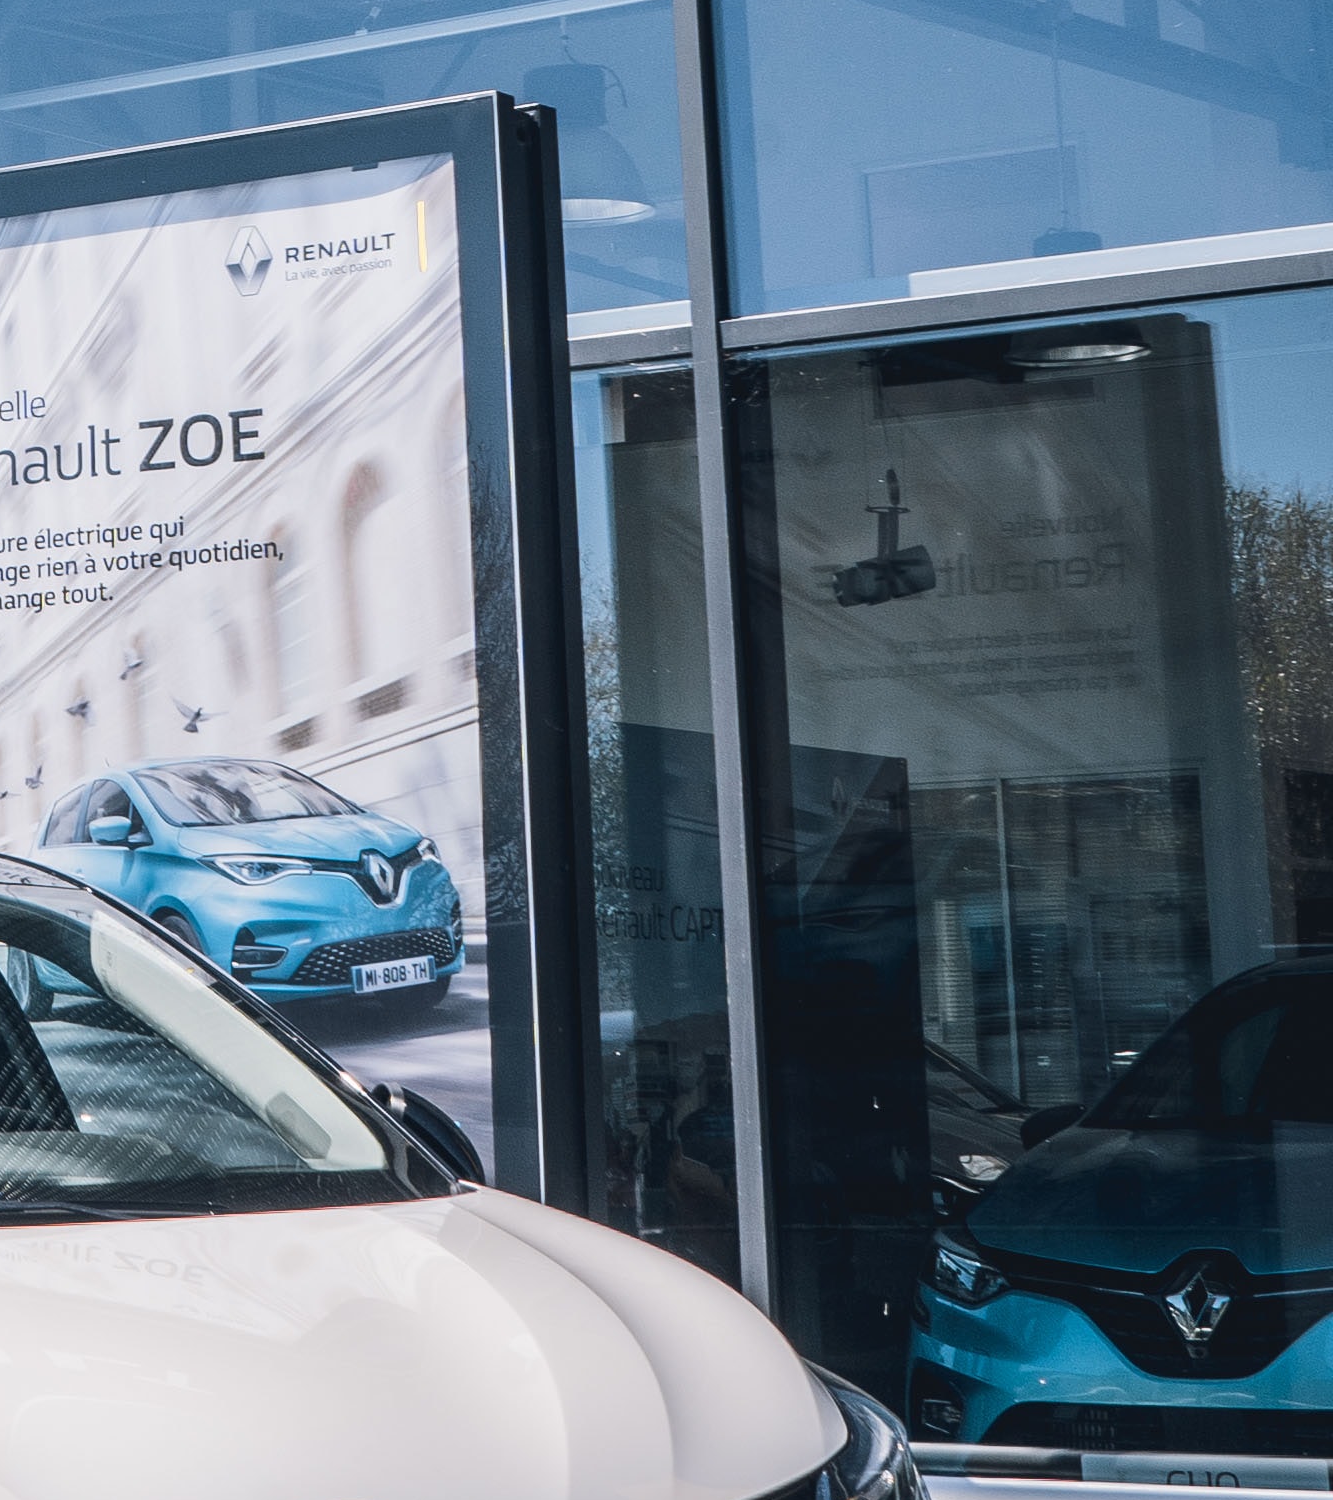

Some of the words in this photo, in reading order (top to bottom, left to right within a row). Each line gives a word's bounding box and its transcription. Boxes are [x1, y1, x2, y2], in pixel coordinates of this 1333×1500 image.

[284, 232, 396, 264] RENAULT
[284, 269, 298, 282] La
[299, 266, 319, 280] vie,
[321, 265, 348, 277] avec
[349, 257, 392, 276] passion
[138, 408, 266, 473] ZOE
[34, 522, 143, 551] électrique
[149, 516, 185, 545] qui
[36, 556, 79, 580] rien
[84, 553, 98, 575] à
[103, 550, 163, 573] votre
[169, 540, 285, 572] quotidien,
[63, 583, 115, 605] tout.
[365, 960, 428, 988] MI-808-TH
